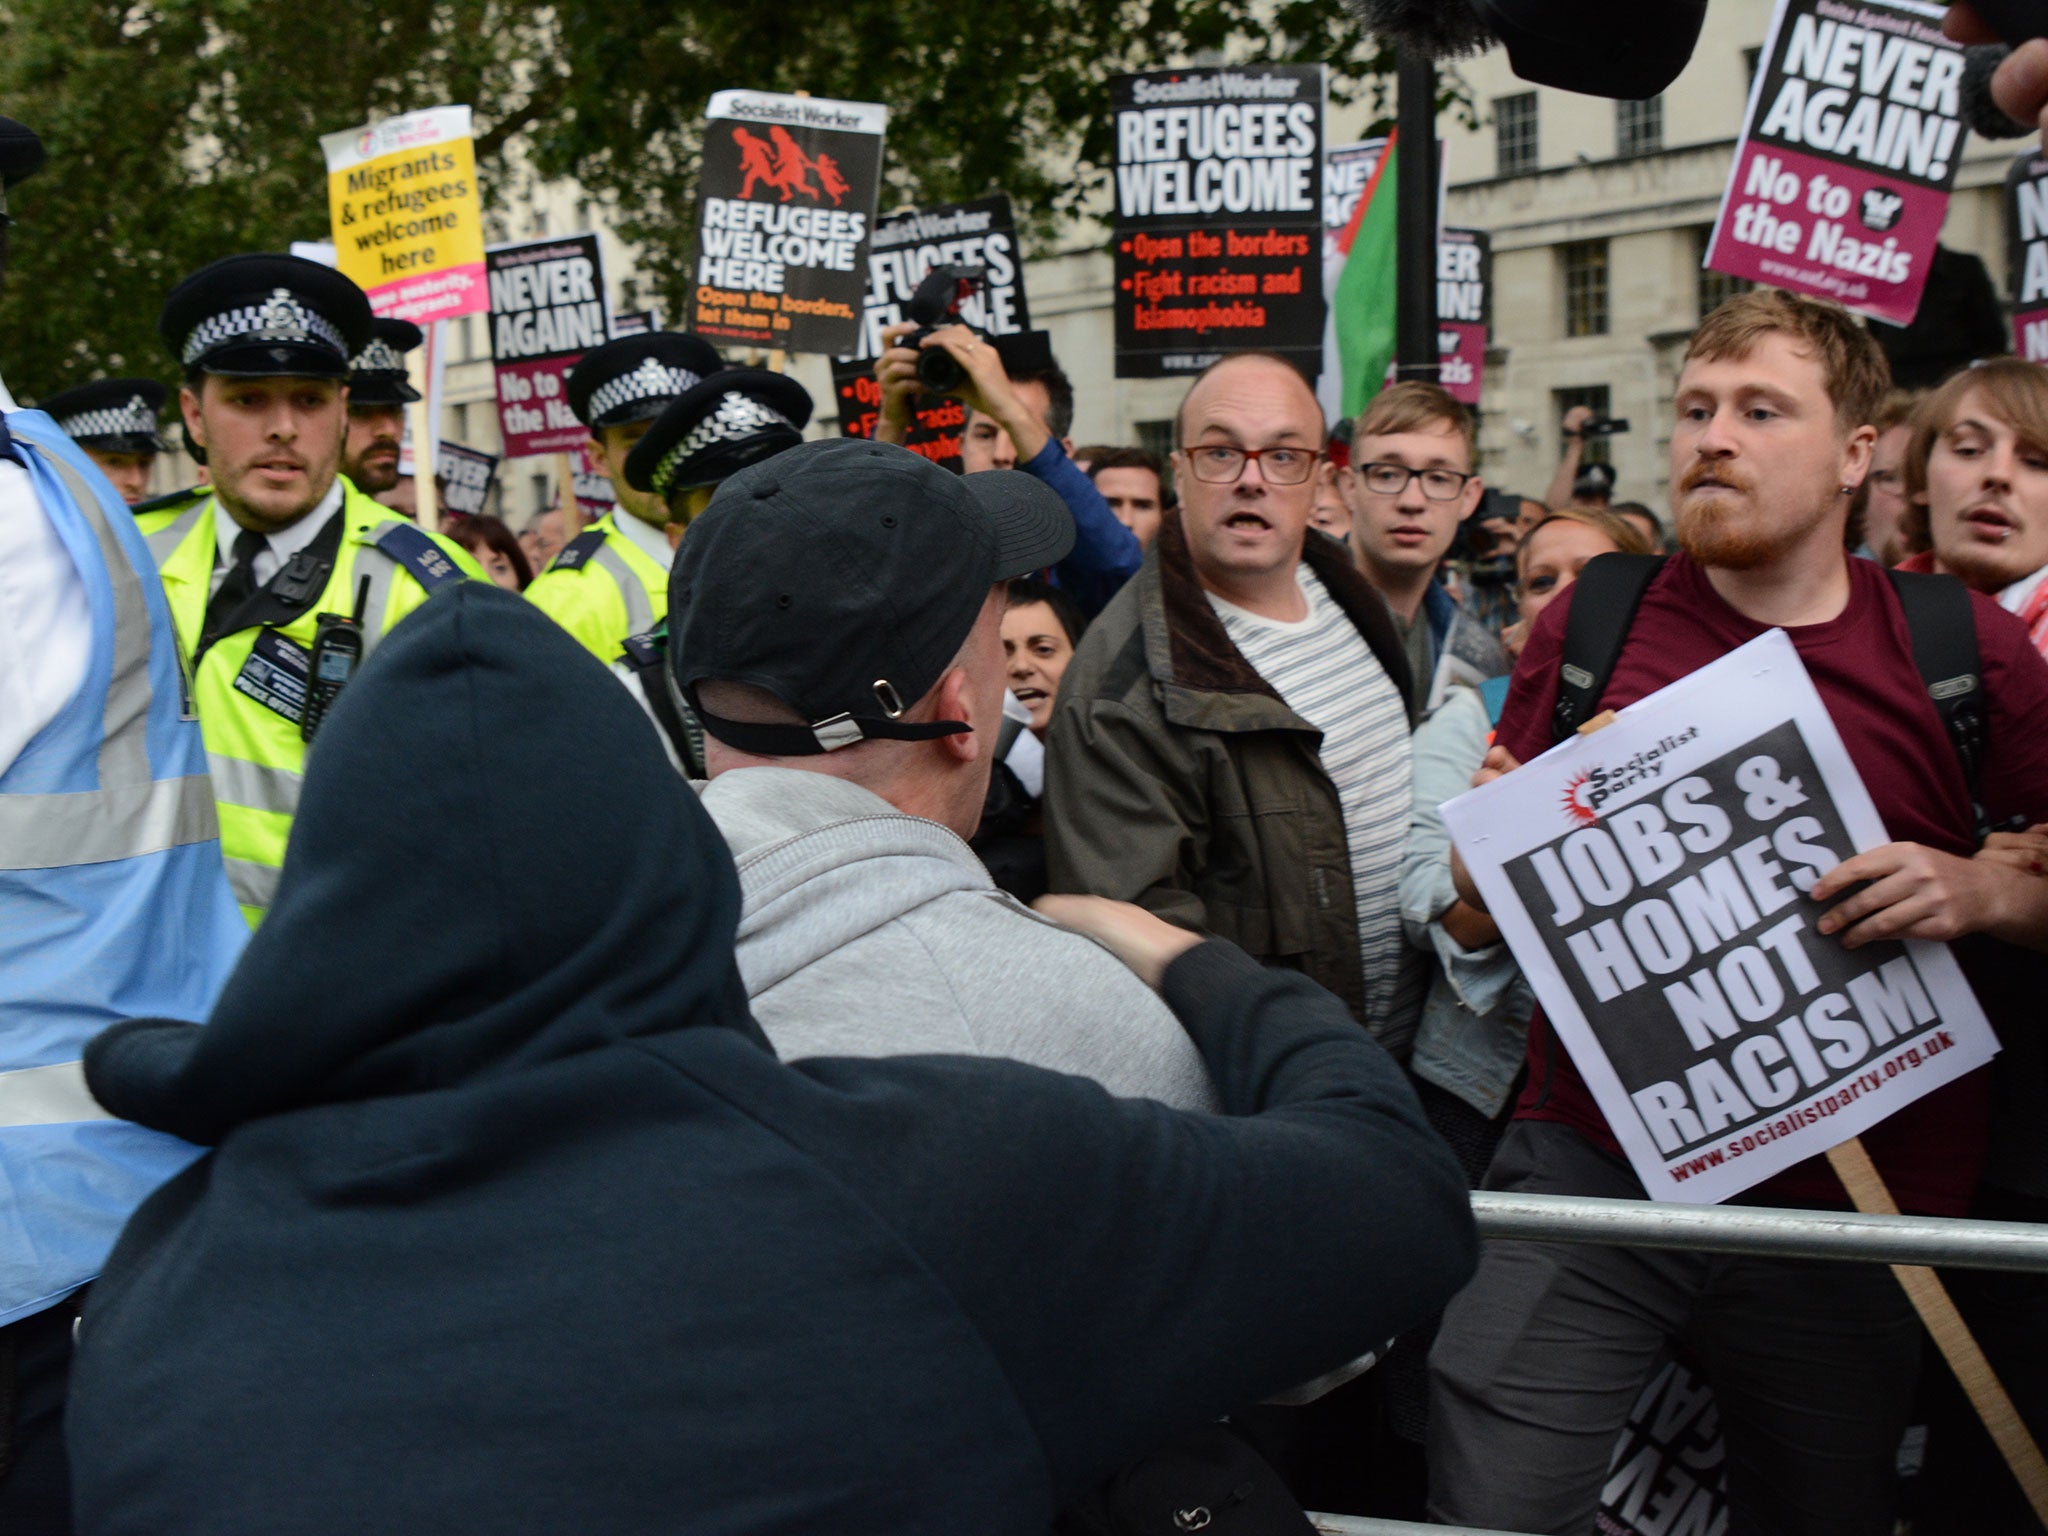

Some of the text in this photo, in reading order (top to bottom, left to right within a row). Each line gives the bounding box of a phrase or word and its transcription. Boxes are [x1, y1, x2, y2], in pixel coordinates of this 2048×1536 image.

[1782, 13, 1966, 116] NEVER
[1133, 72, 1299, 104] Socialist Worker
[729, 99, 862, 127] Socialist Worker
[1117, 102, 1316, 164] REFUGEES
[1760, 78, 1961, 181] AGAIN!
[348, 151, 456, 194] Migrants
[1117, 157, 1314, 217] WELCOME
[1745, 155, 1851, 219] No to
[341, 180, 467, 226] & refugees
[703, 197, 866, 243] REFUGEES
[355, 212, 457, 251] welcome
[701, 227, 856, 271] WELCOME
[1132, 228, 1309, 265] Open the borders
[1732, 203, 1913, 284] the Nazis
[381, 248, 435, 275] here
[698, 255, 785, 293] HERE
[1133, 266, 1302, 302] Fight racism and
[1438, 244, 1482, 281] ER
[489, 257, 596, 315] NEVER
[696, 286, 855, 320] Open the borders,
[1437, 281, 1483, 320] IN!
[495, 301, 606, 360] AGAIN!
[696, 304, 791, 331] let them in
[1133, 301, 1266, 334] Islamophobia
[500, 370, 560, 403] No to
[1439, 356, 1473, 384] zis
[504, 403, 543, 435] the
[1588, 725, 1701, 790] Socialist
[1586, 759, 1665, 811] Party
[1529, 755, 1810, 927] JOBS &
[1565, 815, 1841, 1003] HOMES
[1663, 913, 1822, 1052] NOT
[1631, 955, 1939, 1156] RACISM
[1668, 1030, 1956, 1185] www.socialistparty.org.uk
